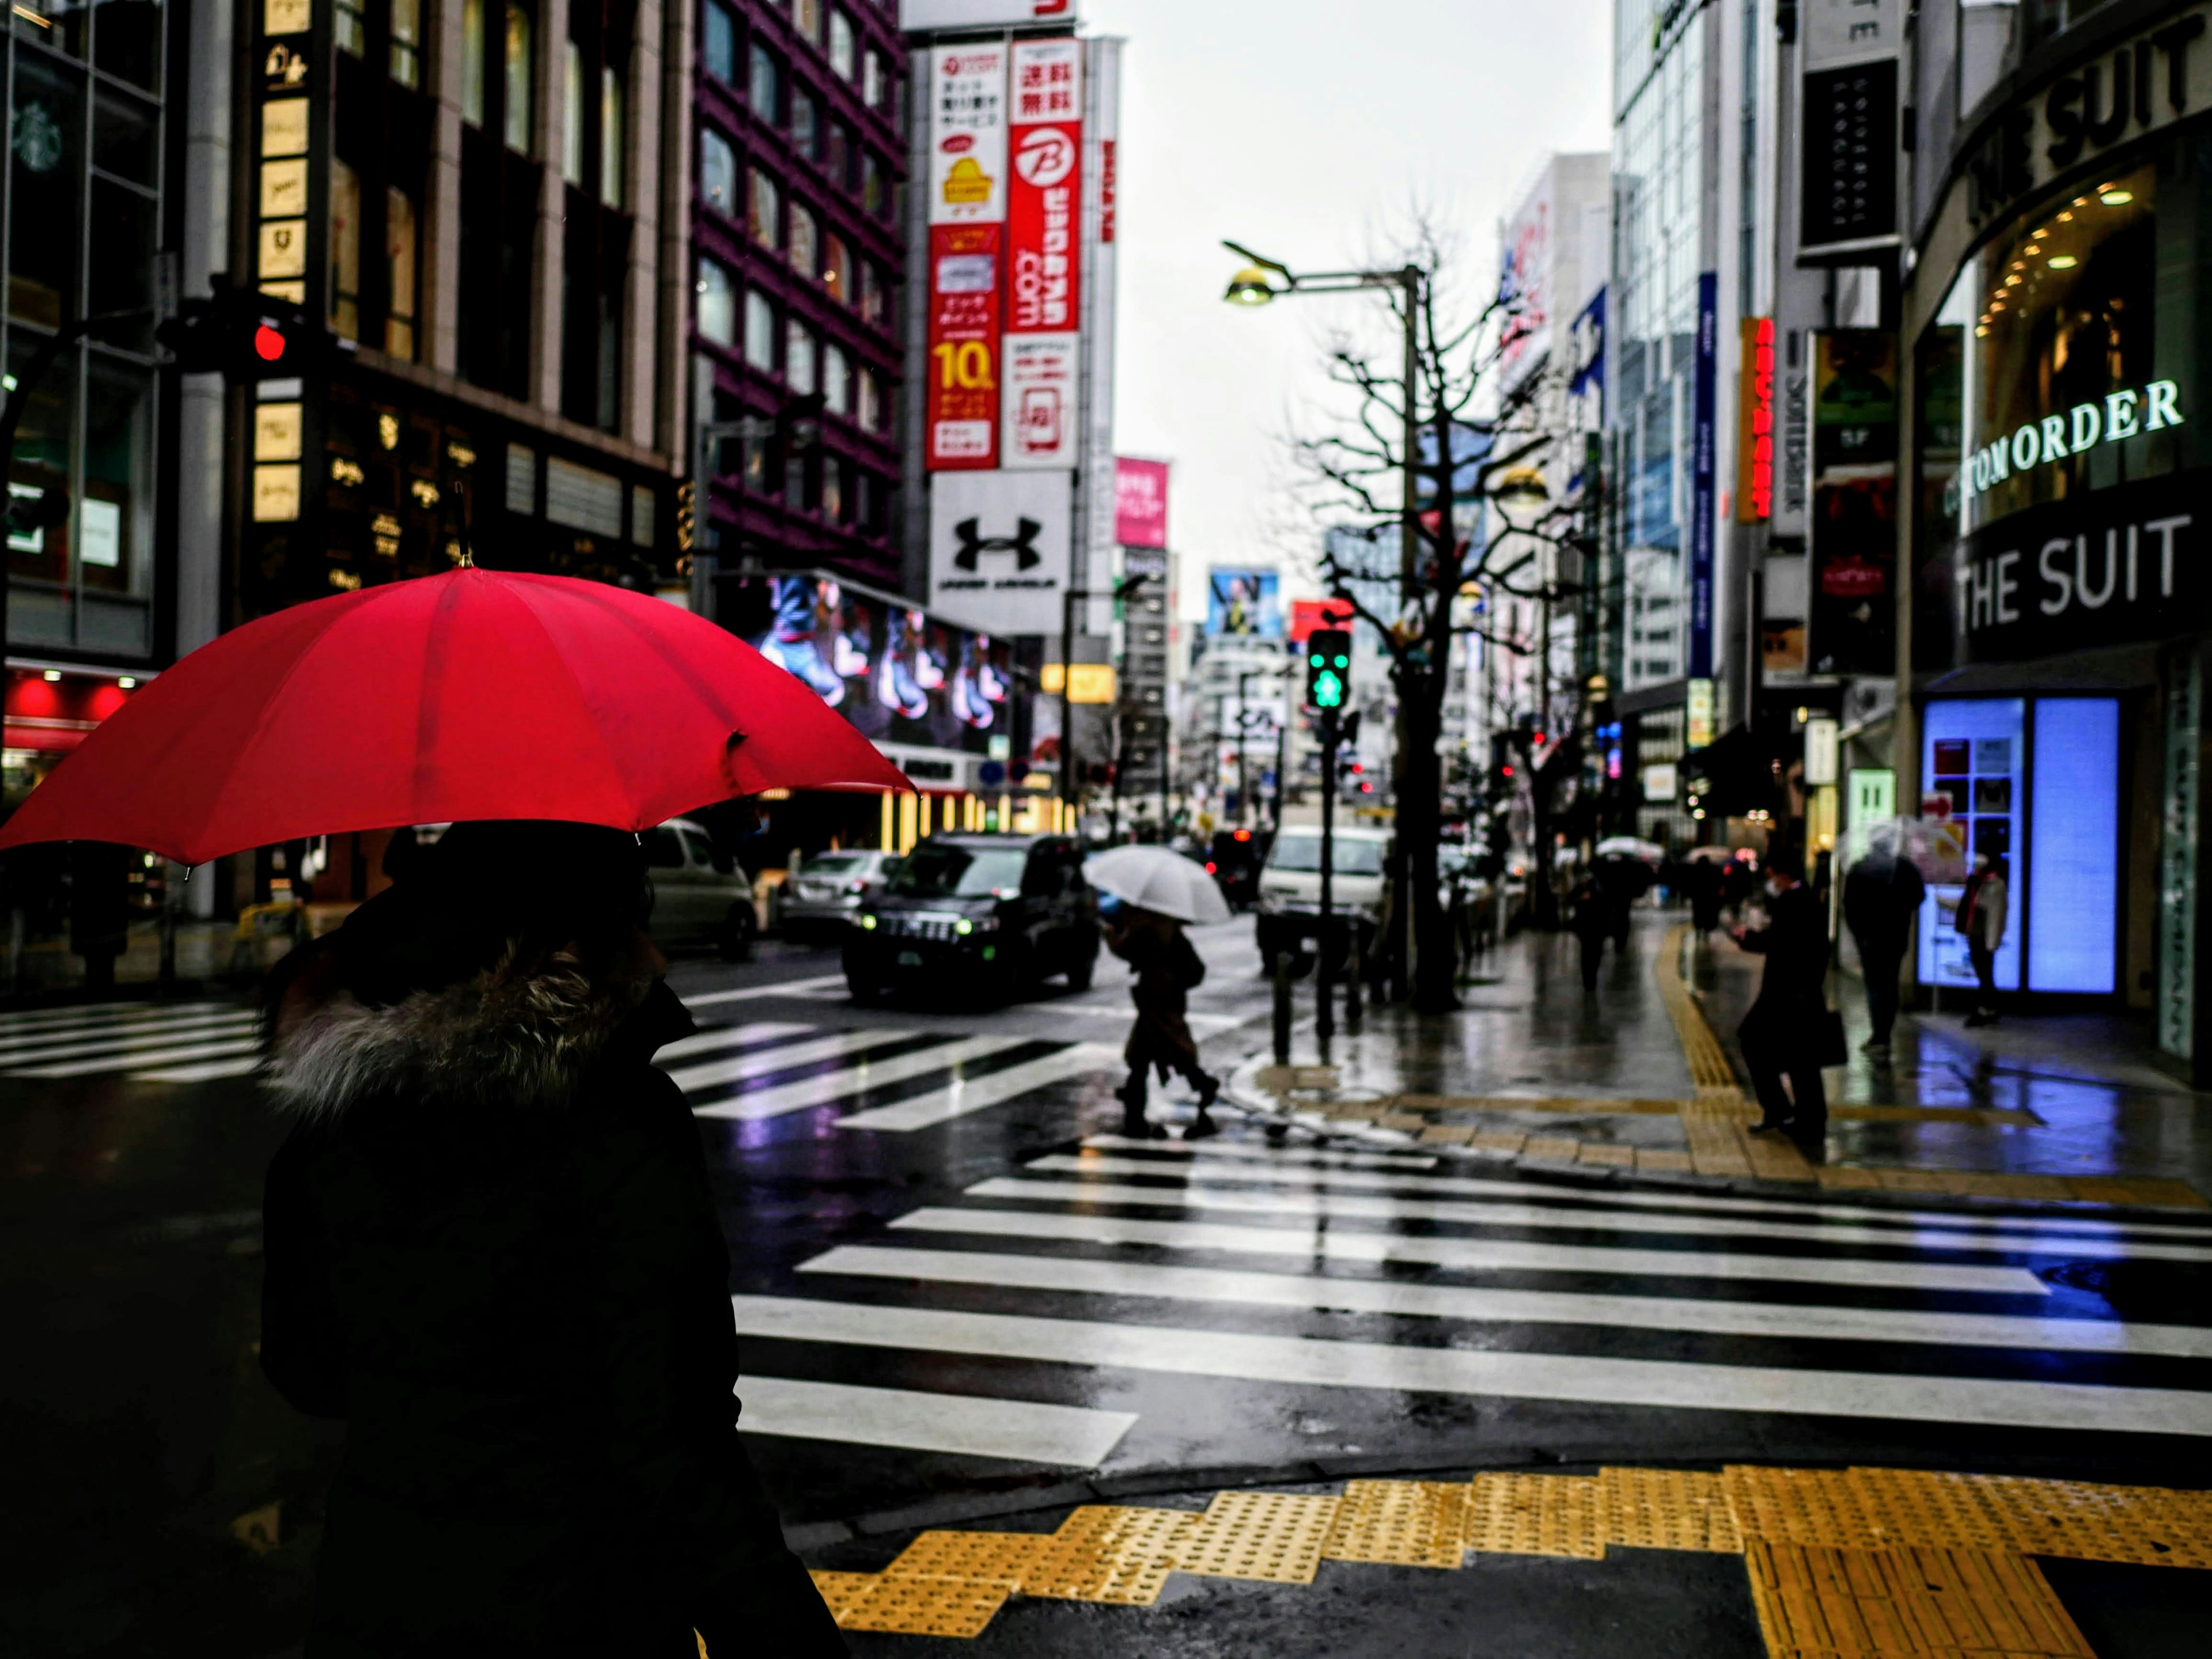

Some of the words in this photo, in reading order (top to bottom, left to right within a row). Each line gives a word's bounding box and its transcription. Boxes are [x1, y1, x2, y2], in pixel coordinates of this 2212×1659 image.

[2047, 13, 2206, 168] SUIT
[2012, 378, 2186, 471] ORDER
[1955, 550, 2022, 637] THE
[2038, 512, 2194, 617] SUIT
